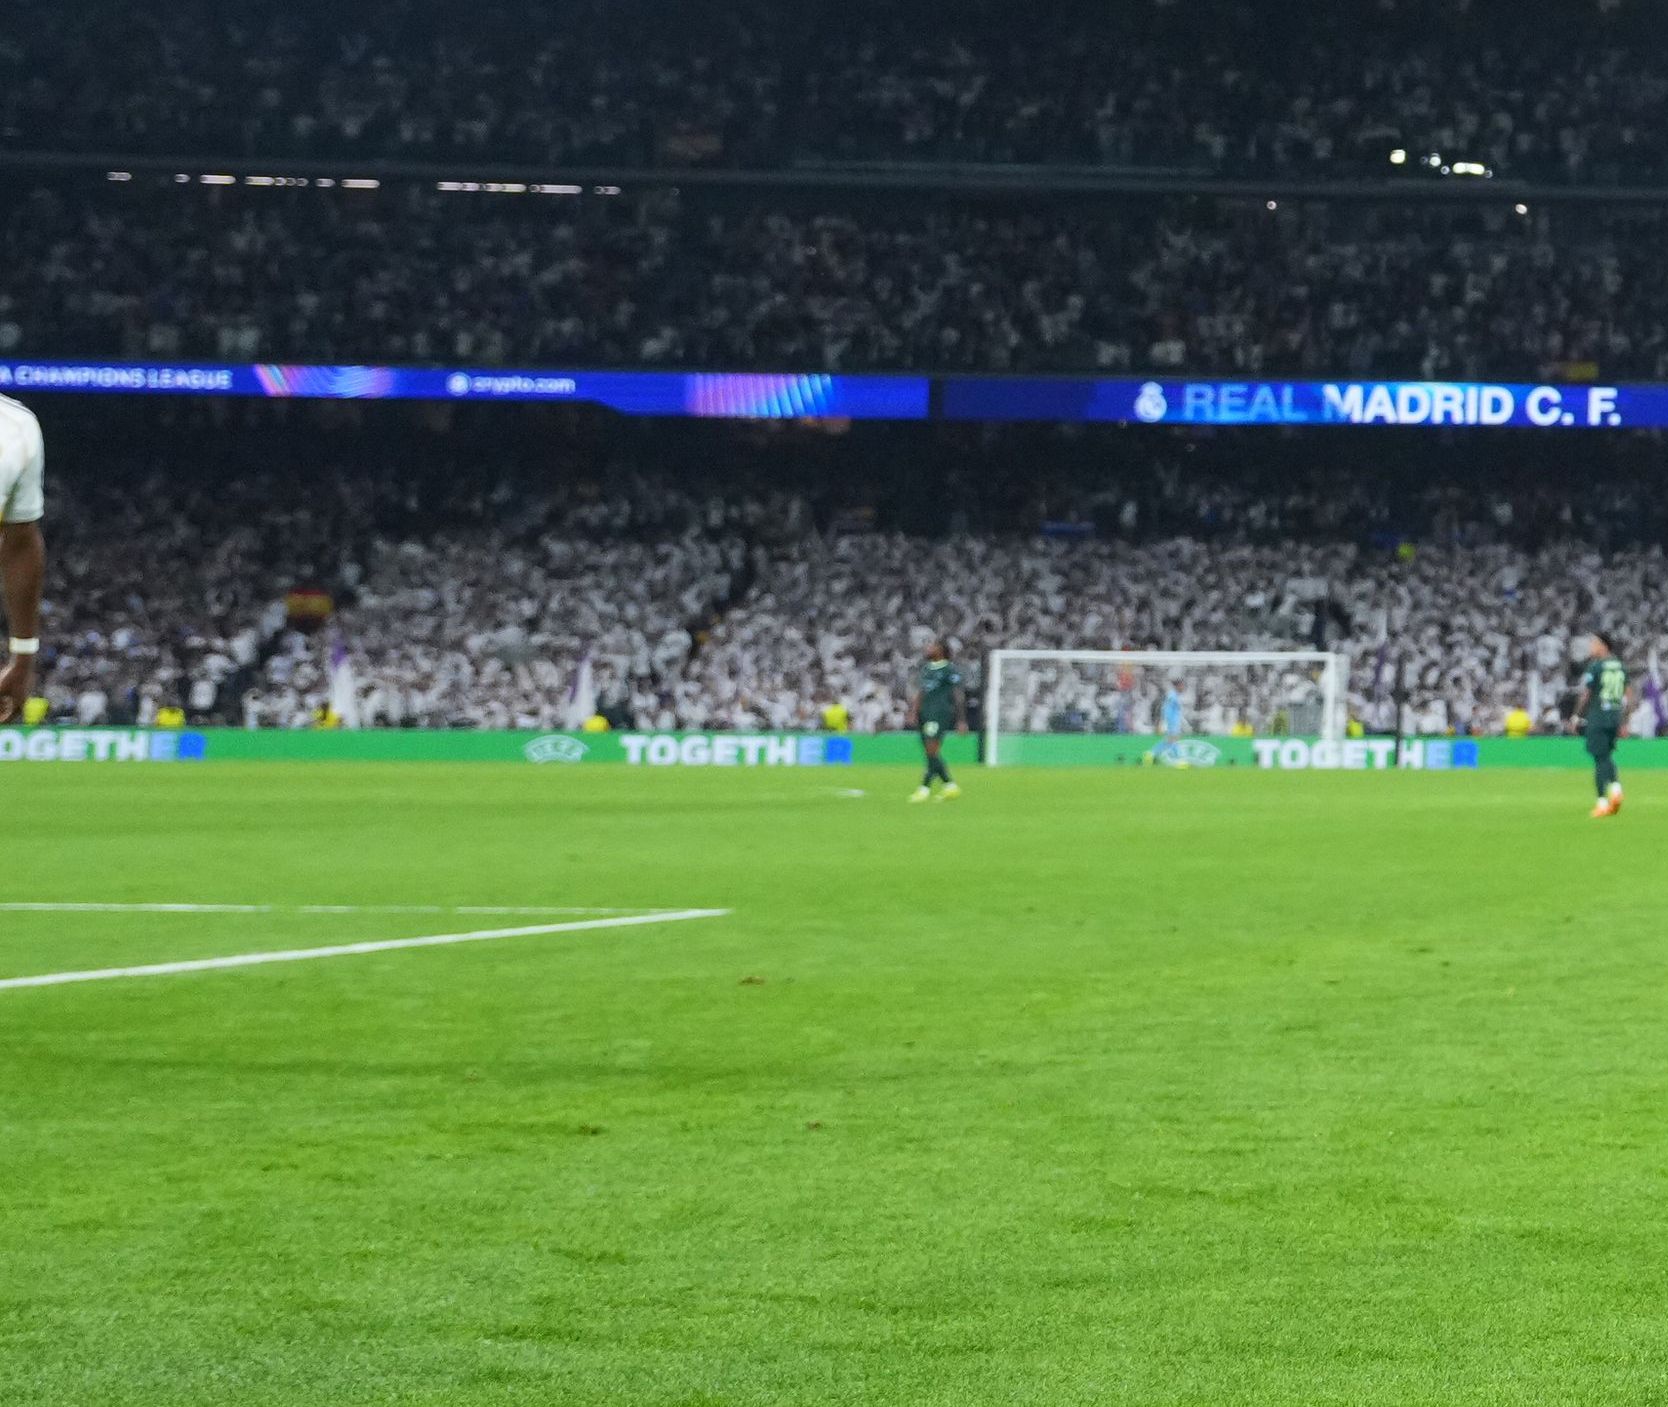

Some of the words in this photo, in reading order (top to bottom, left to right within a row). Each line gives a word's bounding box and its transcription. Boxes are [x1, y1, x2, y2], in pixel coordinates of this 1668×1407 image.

[14, 364, 146, 388] CHAMPIONS
[146, 368, 234, 390] LEAGUE
[471, 374, 577, 396] crypto.com
[1182, 384, 1306, 422] REAL
[1321, 384, 1514, 425] MADRID
[1525, 386, 1575, 426] C.
[1587, 388, 1621, 426] F.
[0, 728, 207, 762] OGETHER
[619, 735, 853, 765] TOGETHER
[1253, 739, 1478, 769] TOGETHER
